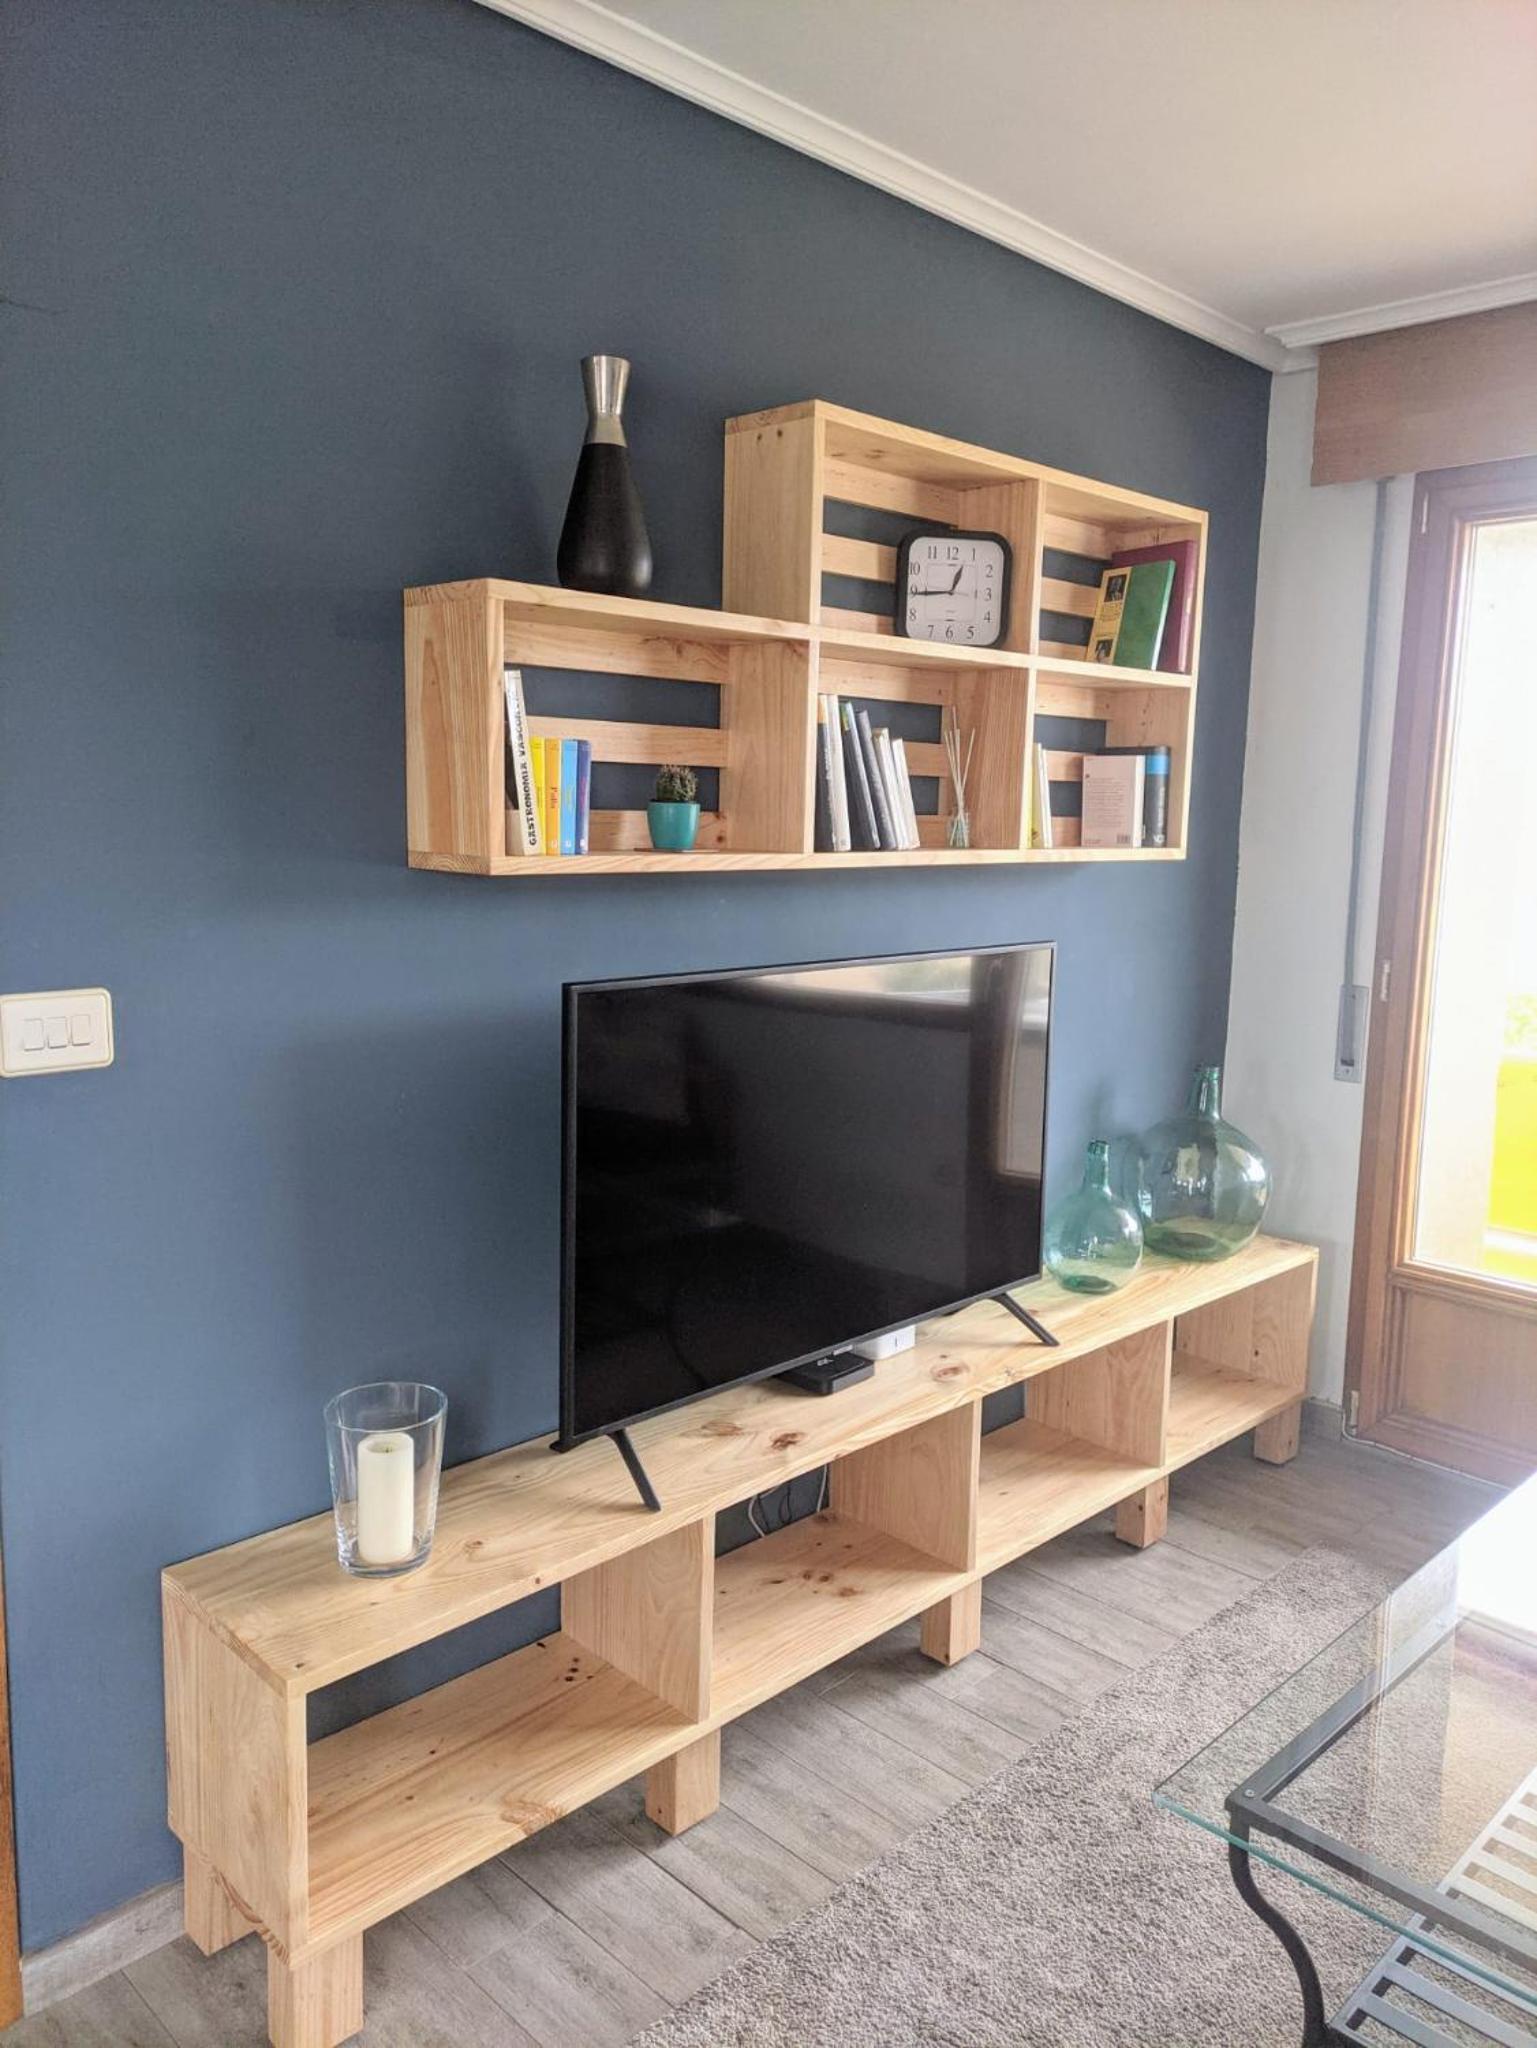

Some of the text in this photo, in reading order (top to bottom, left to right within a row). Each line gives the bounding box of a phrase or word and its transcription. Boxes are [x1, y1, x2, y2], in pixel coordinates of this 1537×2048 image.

[927, 546, 937, 560] 11
[946, 546, 959, 561] 12
[909, 562, 921, 576] 10
[985, 565, 993, 578] 2
[910, 584, 918, 597] 9
[983, 589, 992, 602] 3
[908, 608, 917, 622] 8
[983, 610, 992, 623] 4
[927, 625, 935, 639] 7
[945, 625, 954, 641] 6
[967, 626, 976, 640] 5
[518, 762, 538, 846] GASTRONOMIA
